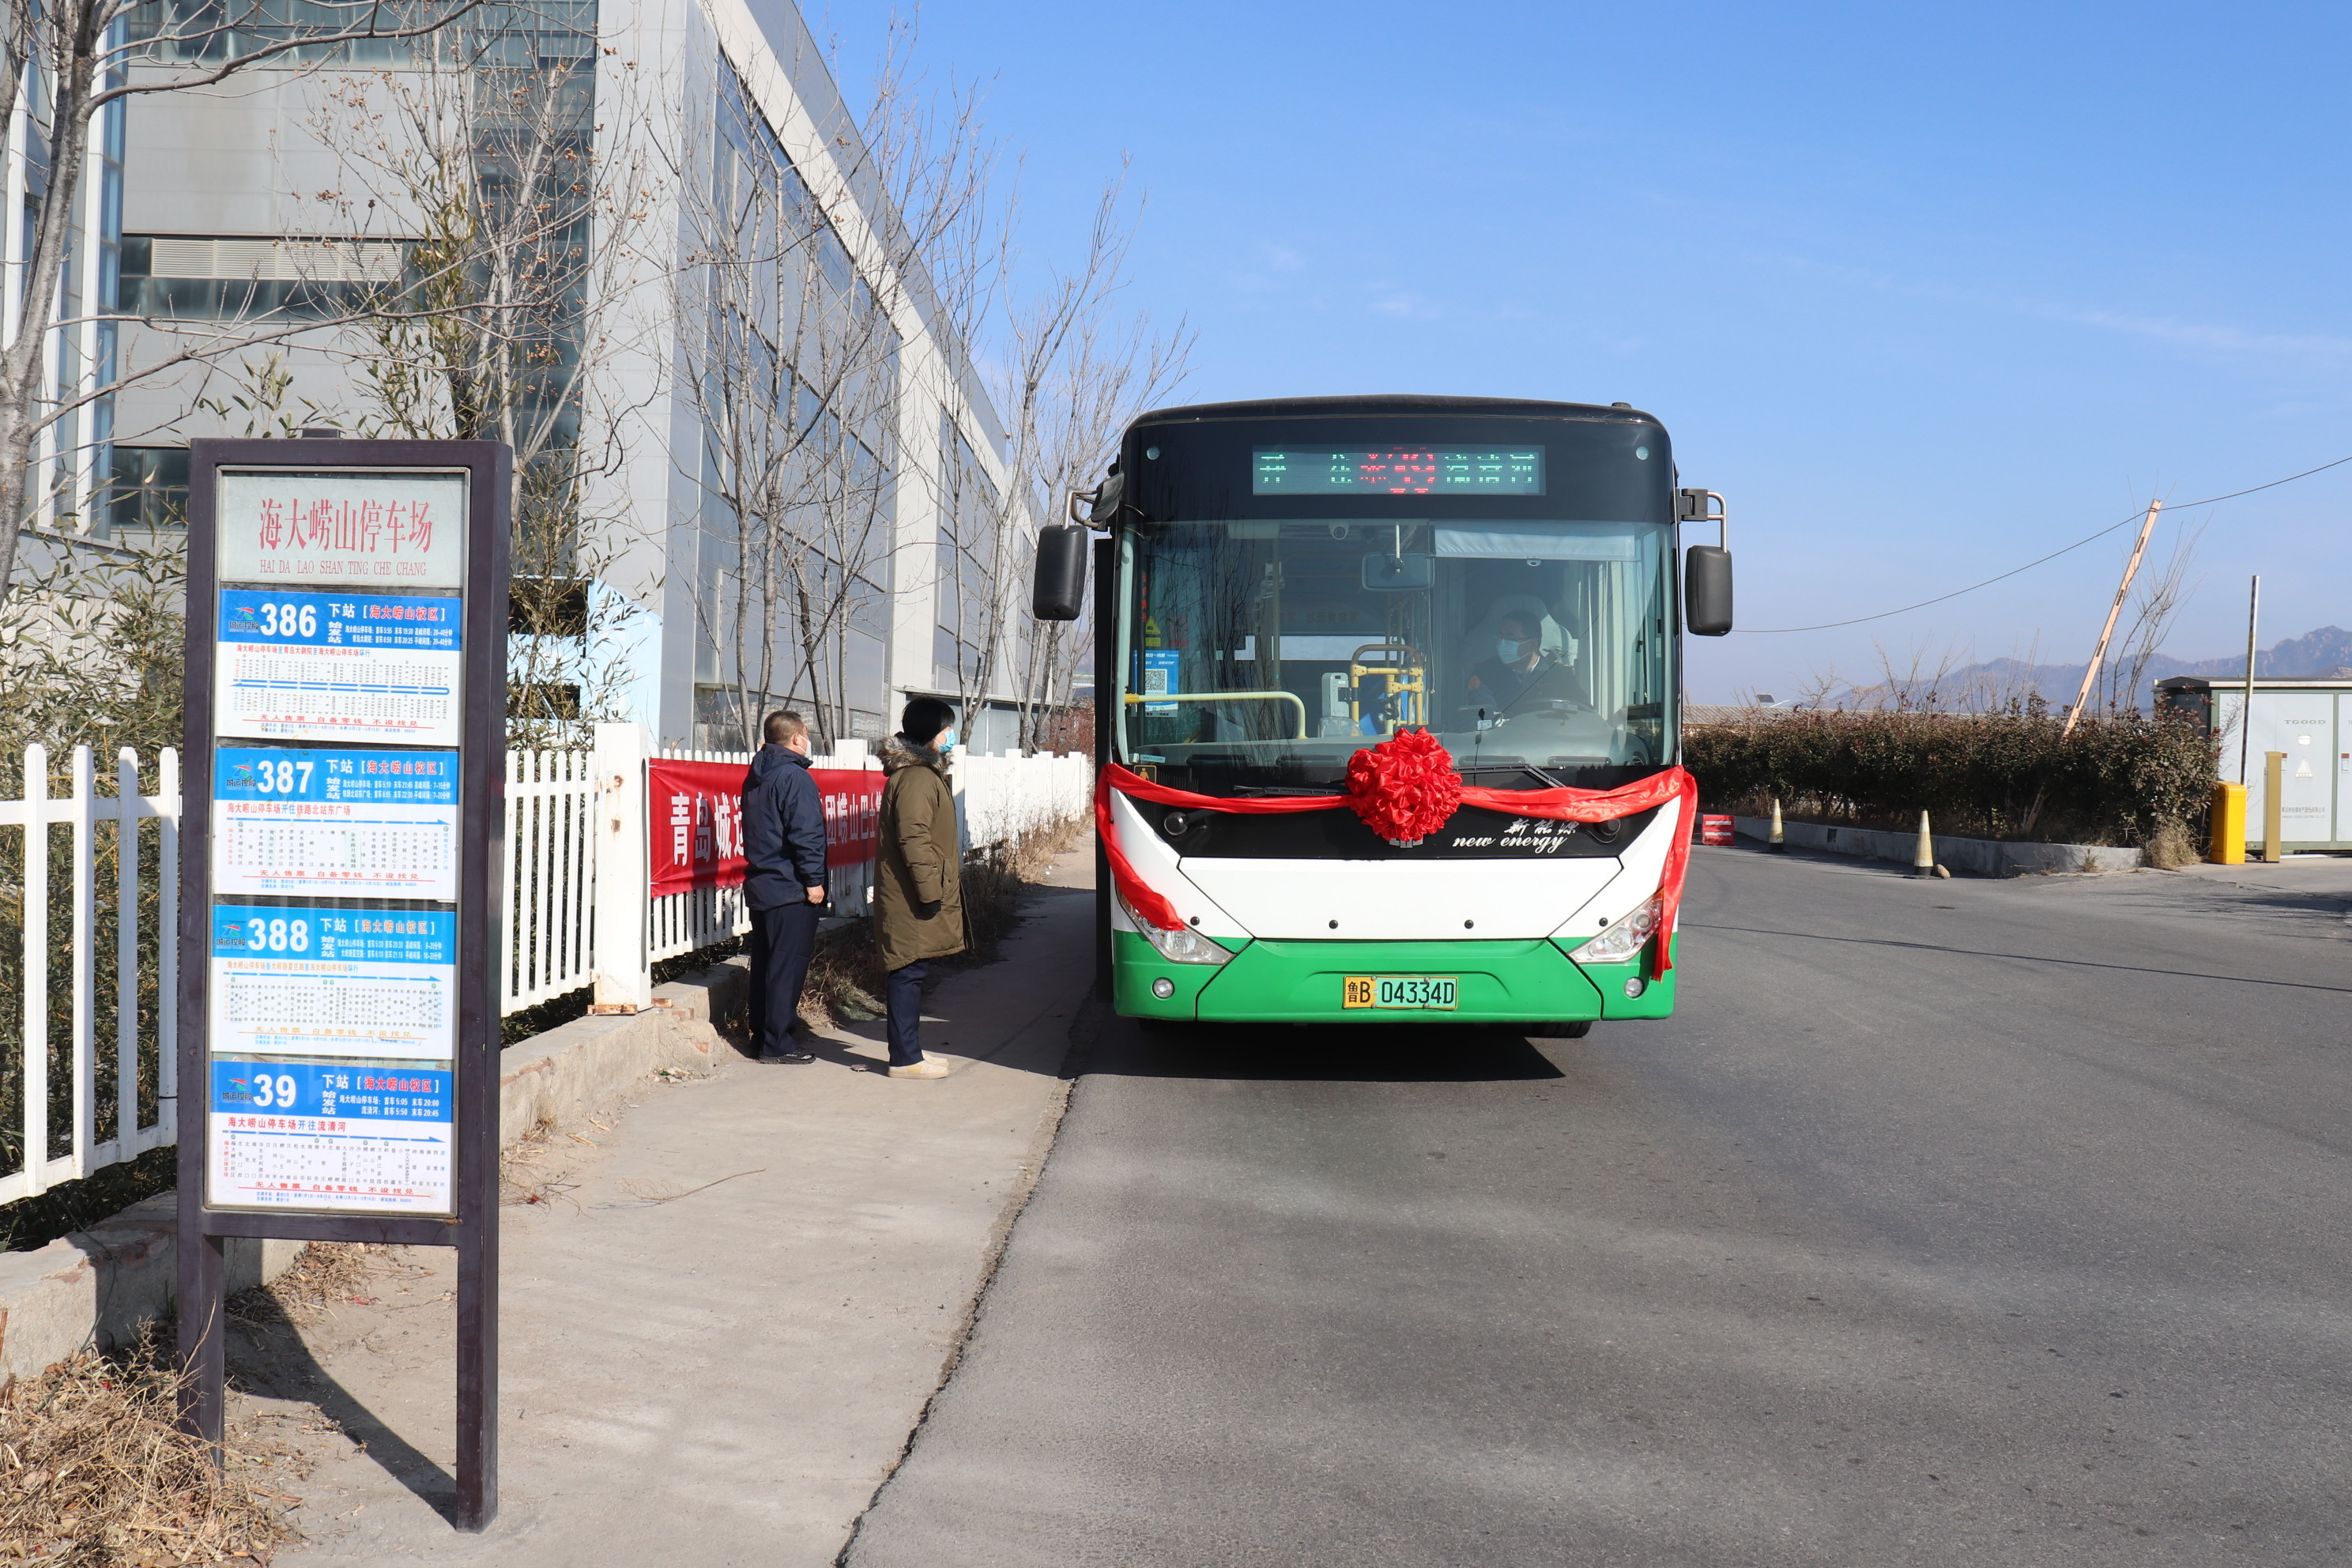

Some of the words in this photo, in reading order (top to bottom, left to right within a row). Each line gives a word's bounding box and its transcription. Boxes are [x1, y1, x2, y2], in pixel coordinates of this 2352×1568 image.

[259, 498, 432, 553] 海大崂山停车场
[260, 560, 274, 574] HAI
[278, 560, 291, 574] DA
[297, 560, 315, 575] LAO
[319, 560, 343, 575] SHAN
[348, 560, 369, 575] TING
[373, 561, 391, 575] CHE
[396, 562, 426, 576] CHANG
[260, 603, 317, 637] 386
[329, 603, 355, 618] 下站
[328, 621, 342, 643] 始发站
[257, 760, 314, 793] 387
[326, 760, 353, 774] 下站
[326, 778, 341, 799] 始发站
[228, 803, 350, 816] 海大崂山停车场开往铁路北站东广场
[820, 791, 883, 846] 团崂山巴士
[1505, 817, 1579, 835] 新能源
[1453, 836, 1496, 847] new
[1500, 836, 1568, 854] energy
[247, 918, 308, 952] 388
[320, 918, 347, 933] 下站
[321, 936, 335, 958] 始发站
[1348, 982, 1370, 1003] 鲁B
[1381, 981, 1454, 1004] 04334D
[253, 1074, 296, 1107] 39
[322, 1075, 349, 1089] 下站
[322, 1091, 336, 1114] 始发站
[228, 1117, 346, 1132] 海大崂山停车场开往流清河
